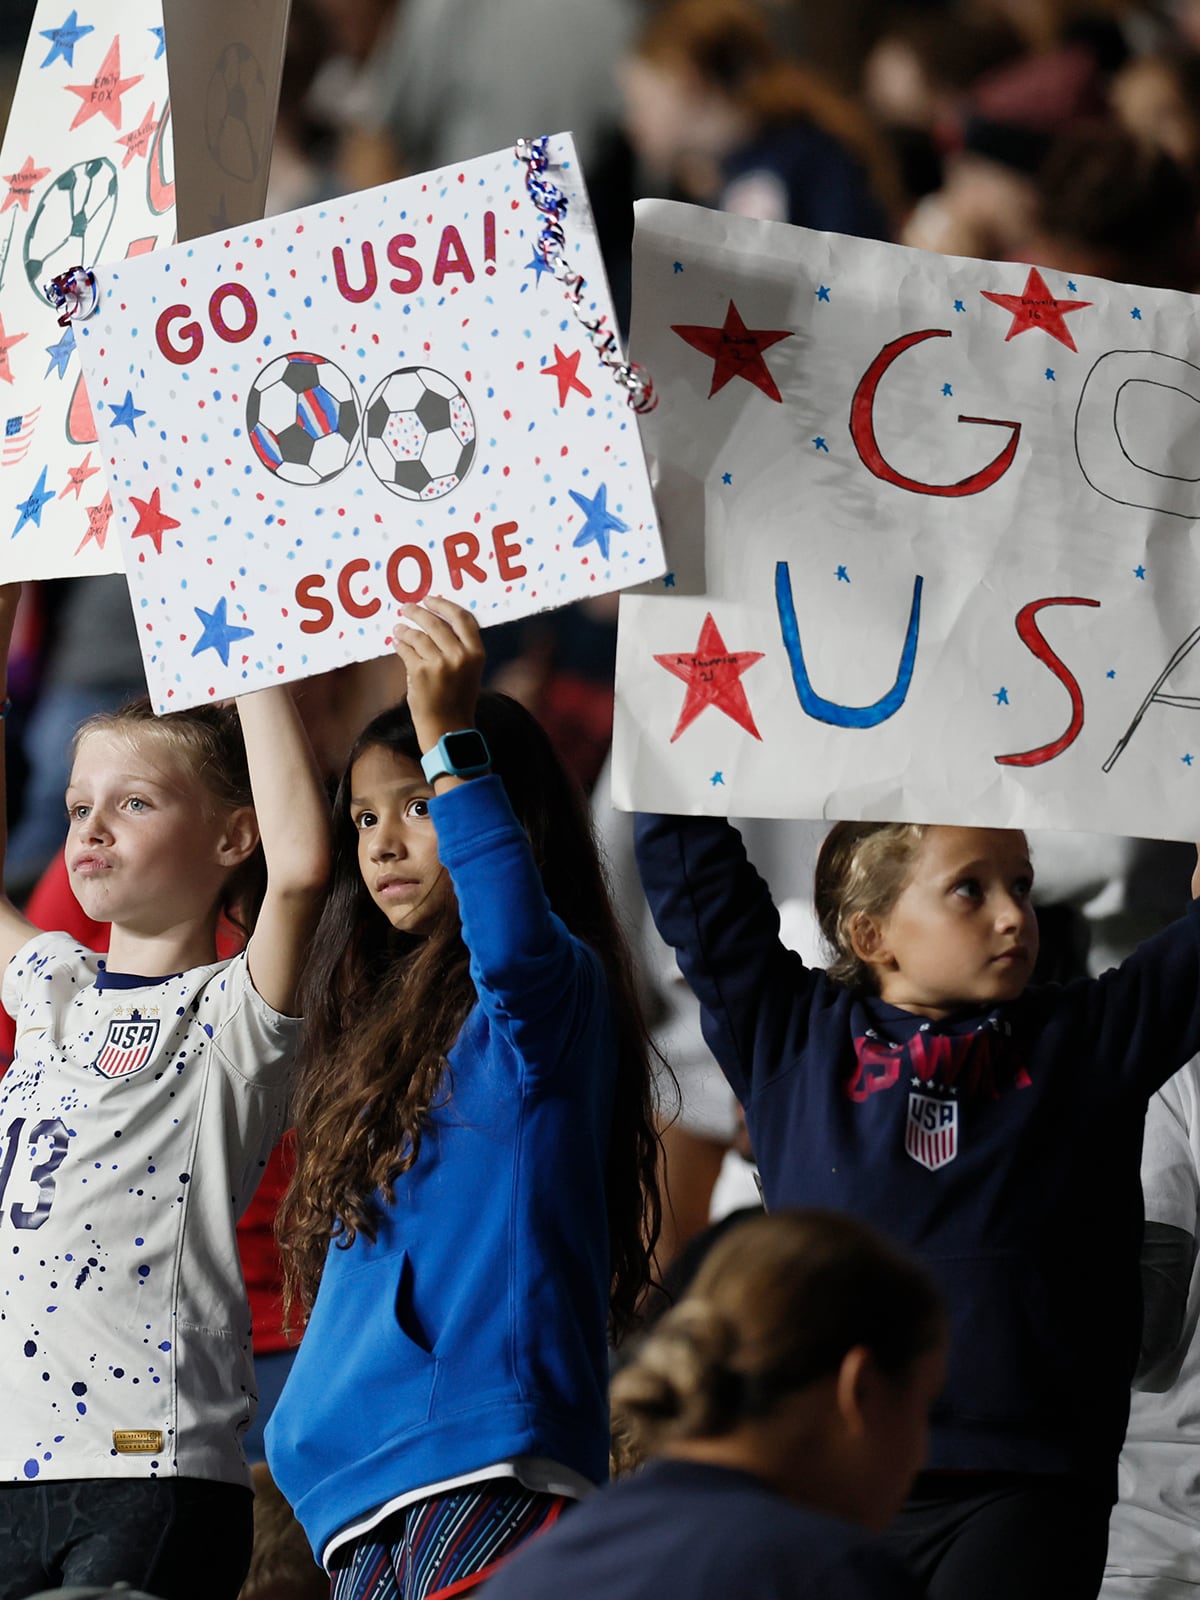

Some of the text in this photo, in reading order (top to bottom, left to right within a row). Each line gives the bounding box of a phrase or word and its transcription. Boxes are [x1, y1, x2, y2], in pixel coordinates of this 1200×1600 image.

[90, 90, 112, 103] FOX
[156, 210, 497, 364] GO USA!
[1028, 309, 1041, 319] 16
[295, 521, 527, 634] SCORE
[110, 1026, 154, 1049] USA
[911, 1098, 954, 1132] USA
